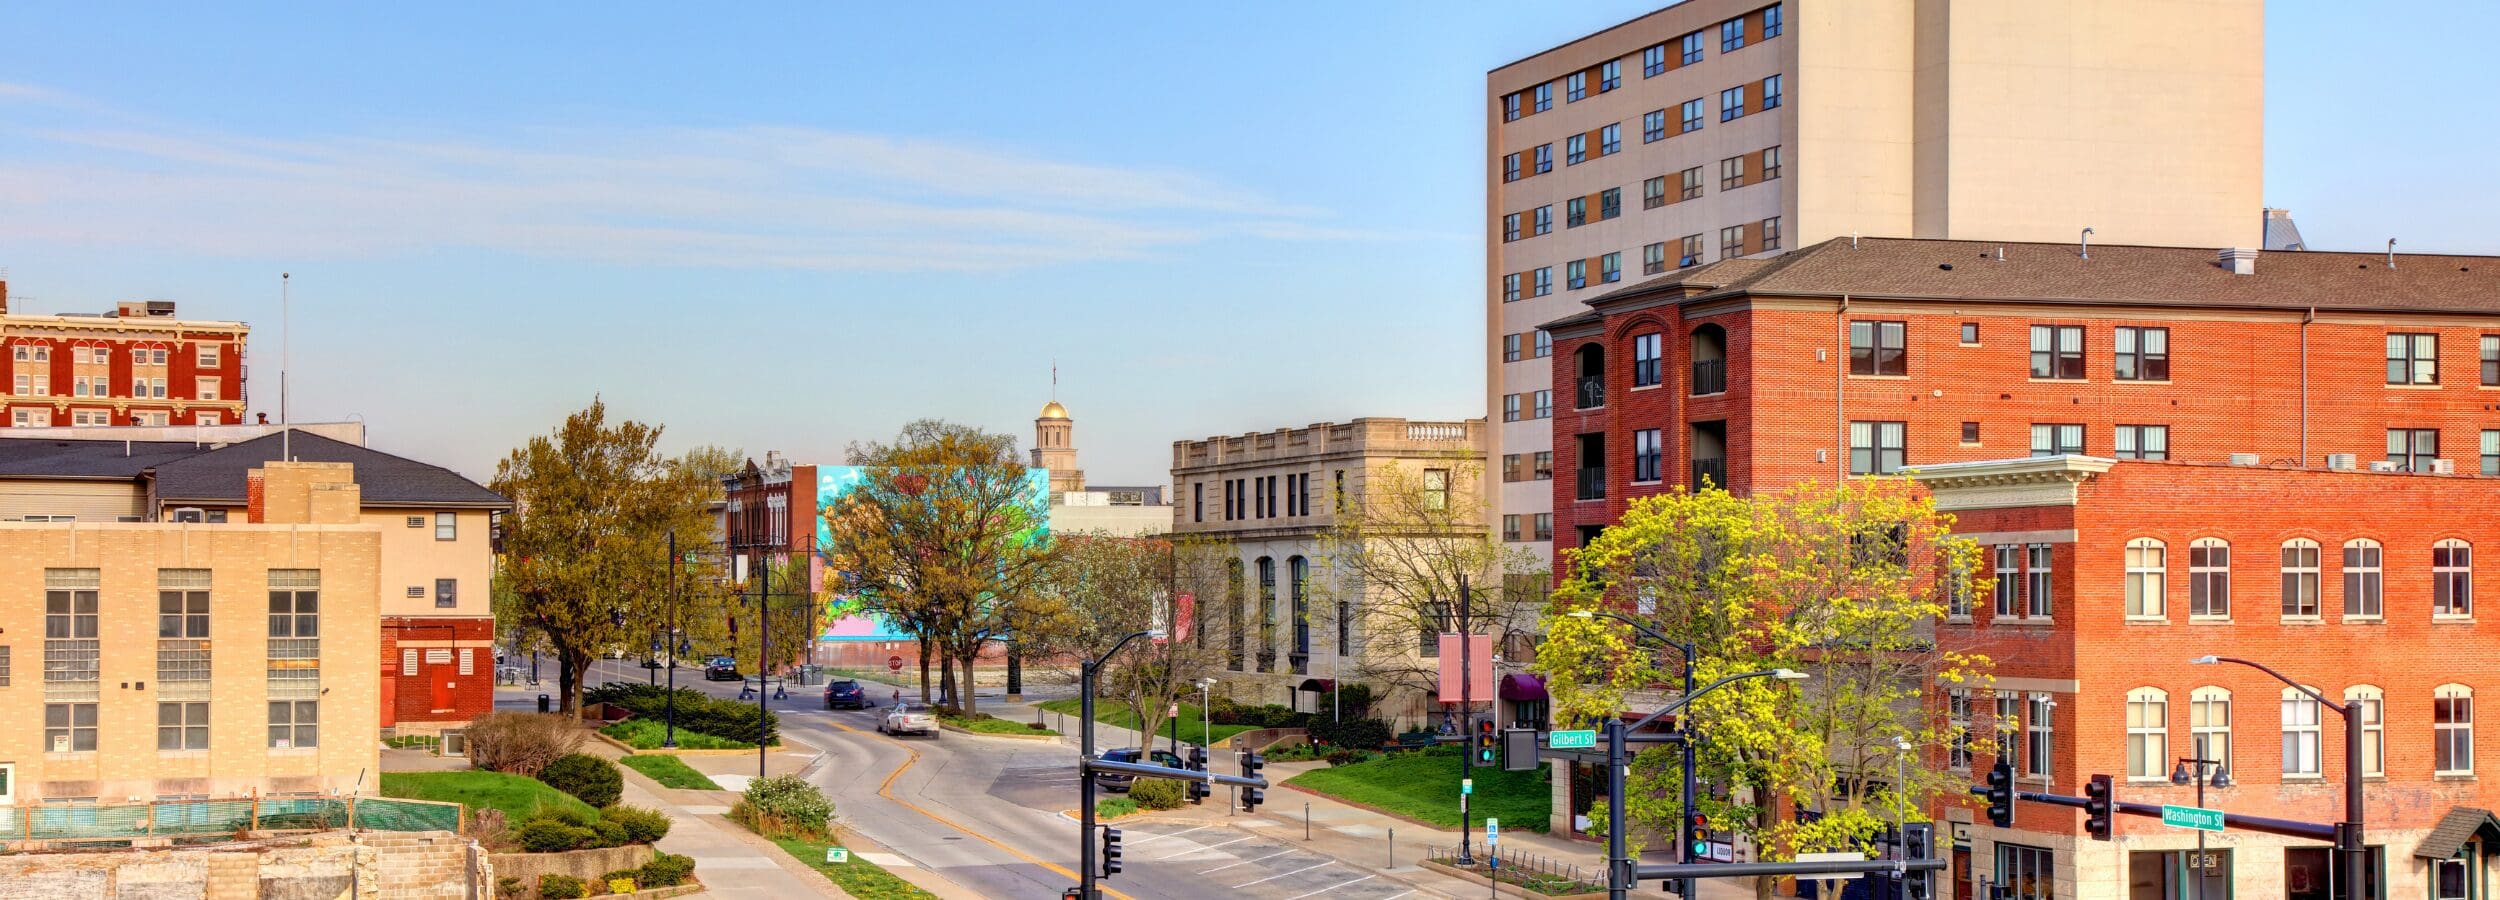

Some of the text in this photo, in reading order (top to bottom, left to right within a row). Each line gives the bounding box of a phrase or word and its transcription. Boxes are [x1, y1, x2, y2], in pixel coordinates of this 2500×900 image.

[1553, 734, 1593, 745] Gilbert St
[2165, 807, 2222, 827] Washington St
[2191, 856, 2214, 866] OEN
